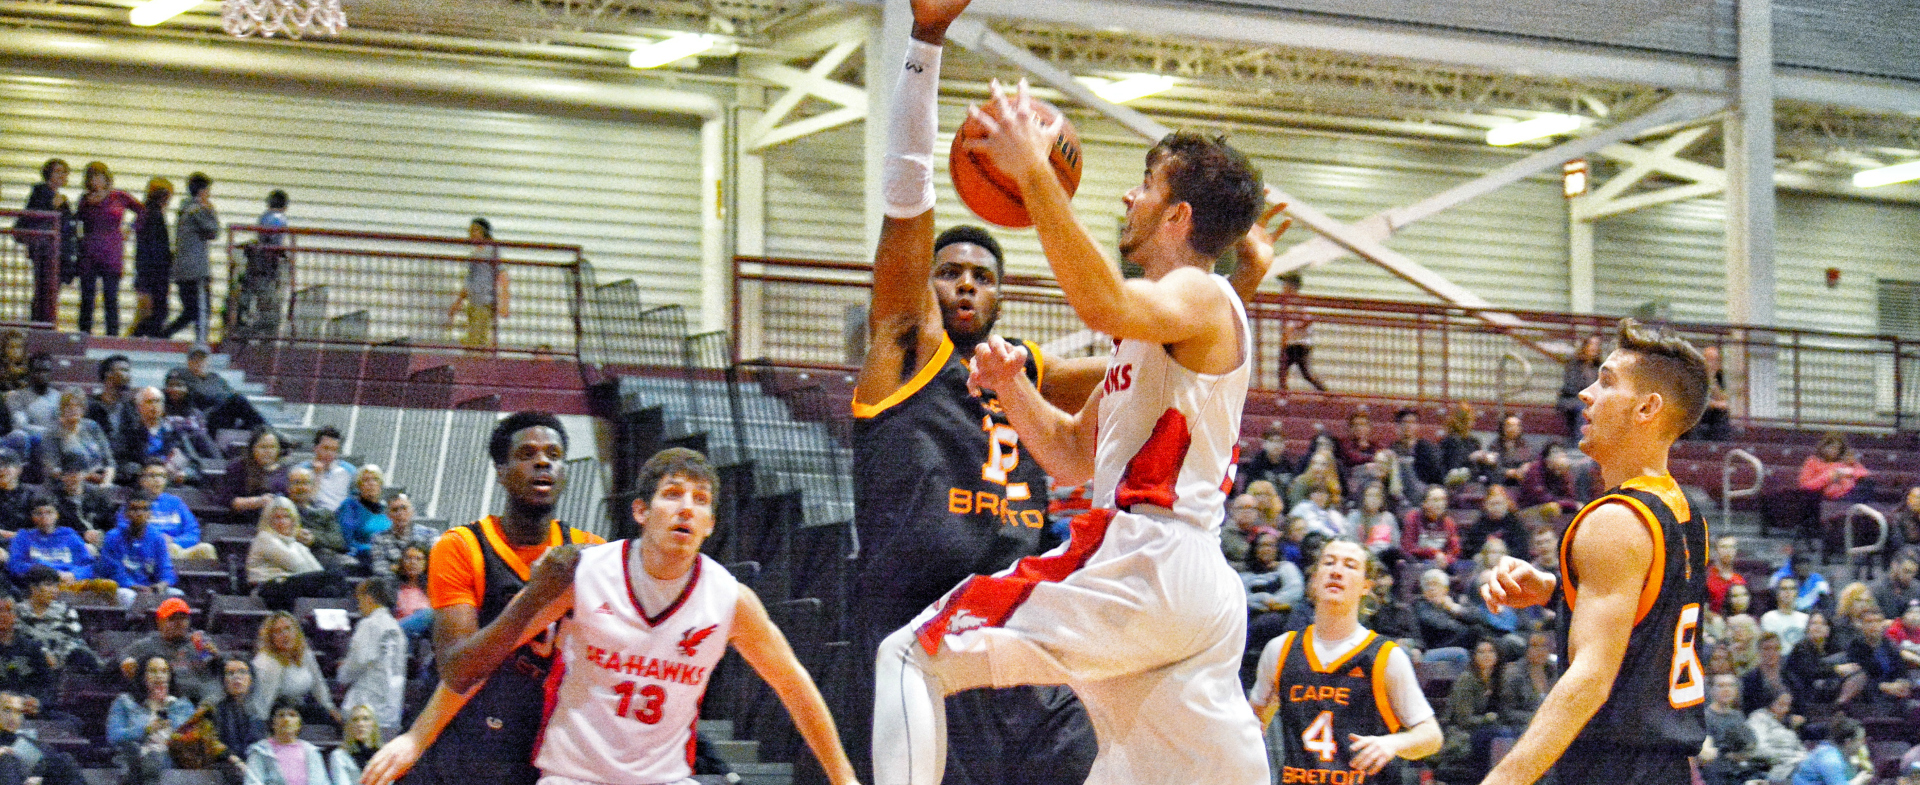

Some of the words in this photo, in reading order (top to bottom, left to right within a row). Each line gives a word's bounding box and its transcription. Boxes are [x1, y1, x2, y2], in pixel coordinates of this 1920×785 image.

[613, 680, 667, 725] 13
[1289, 684, 1352, 706] CAPE
[1301, 710, 1338, 762] 4
[1282, 765, 1367, 785] BRETON
